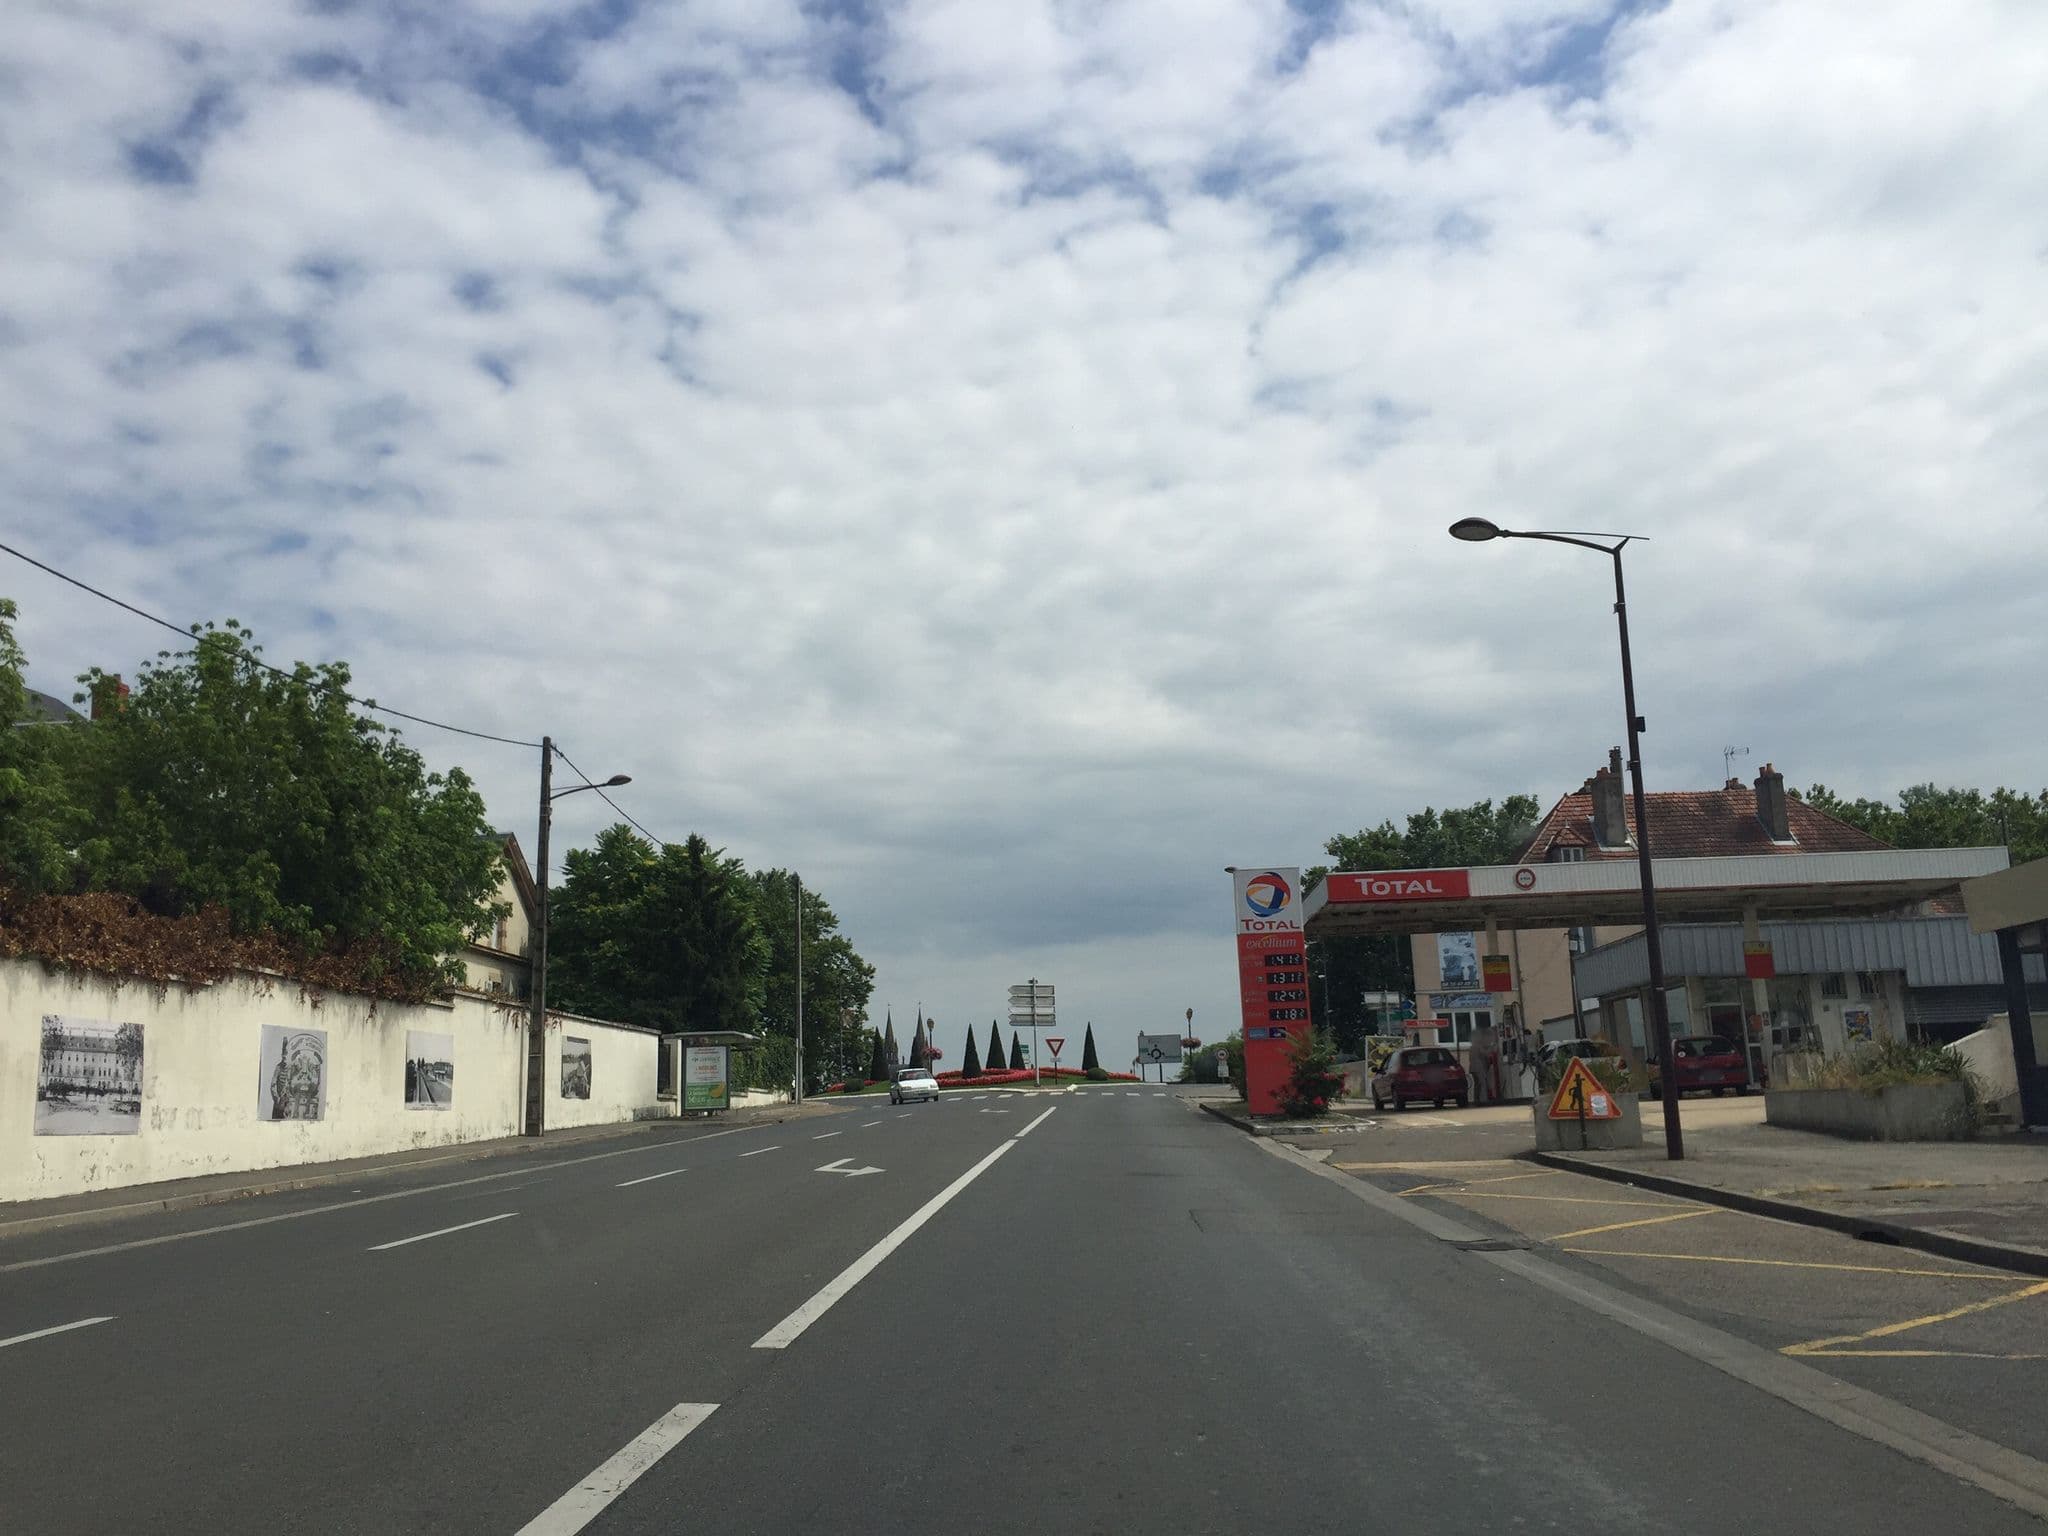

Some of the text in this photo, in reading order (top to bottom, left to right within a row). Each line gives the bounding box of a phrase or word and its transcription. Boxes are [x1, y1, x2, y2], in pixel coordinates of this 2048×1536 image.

[1354, 877, 1443, 896] TOTAL
[1241, 918, 1300, 931] TOTAL
[1246, 936, 1297, 949] excellium
